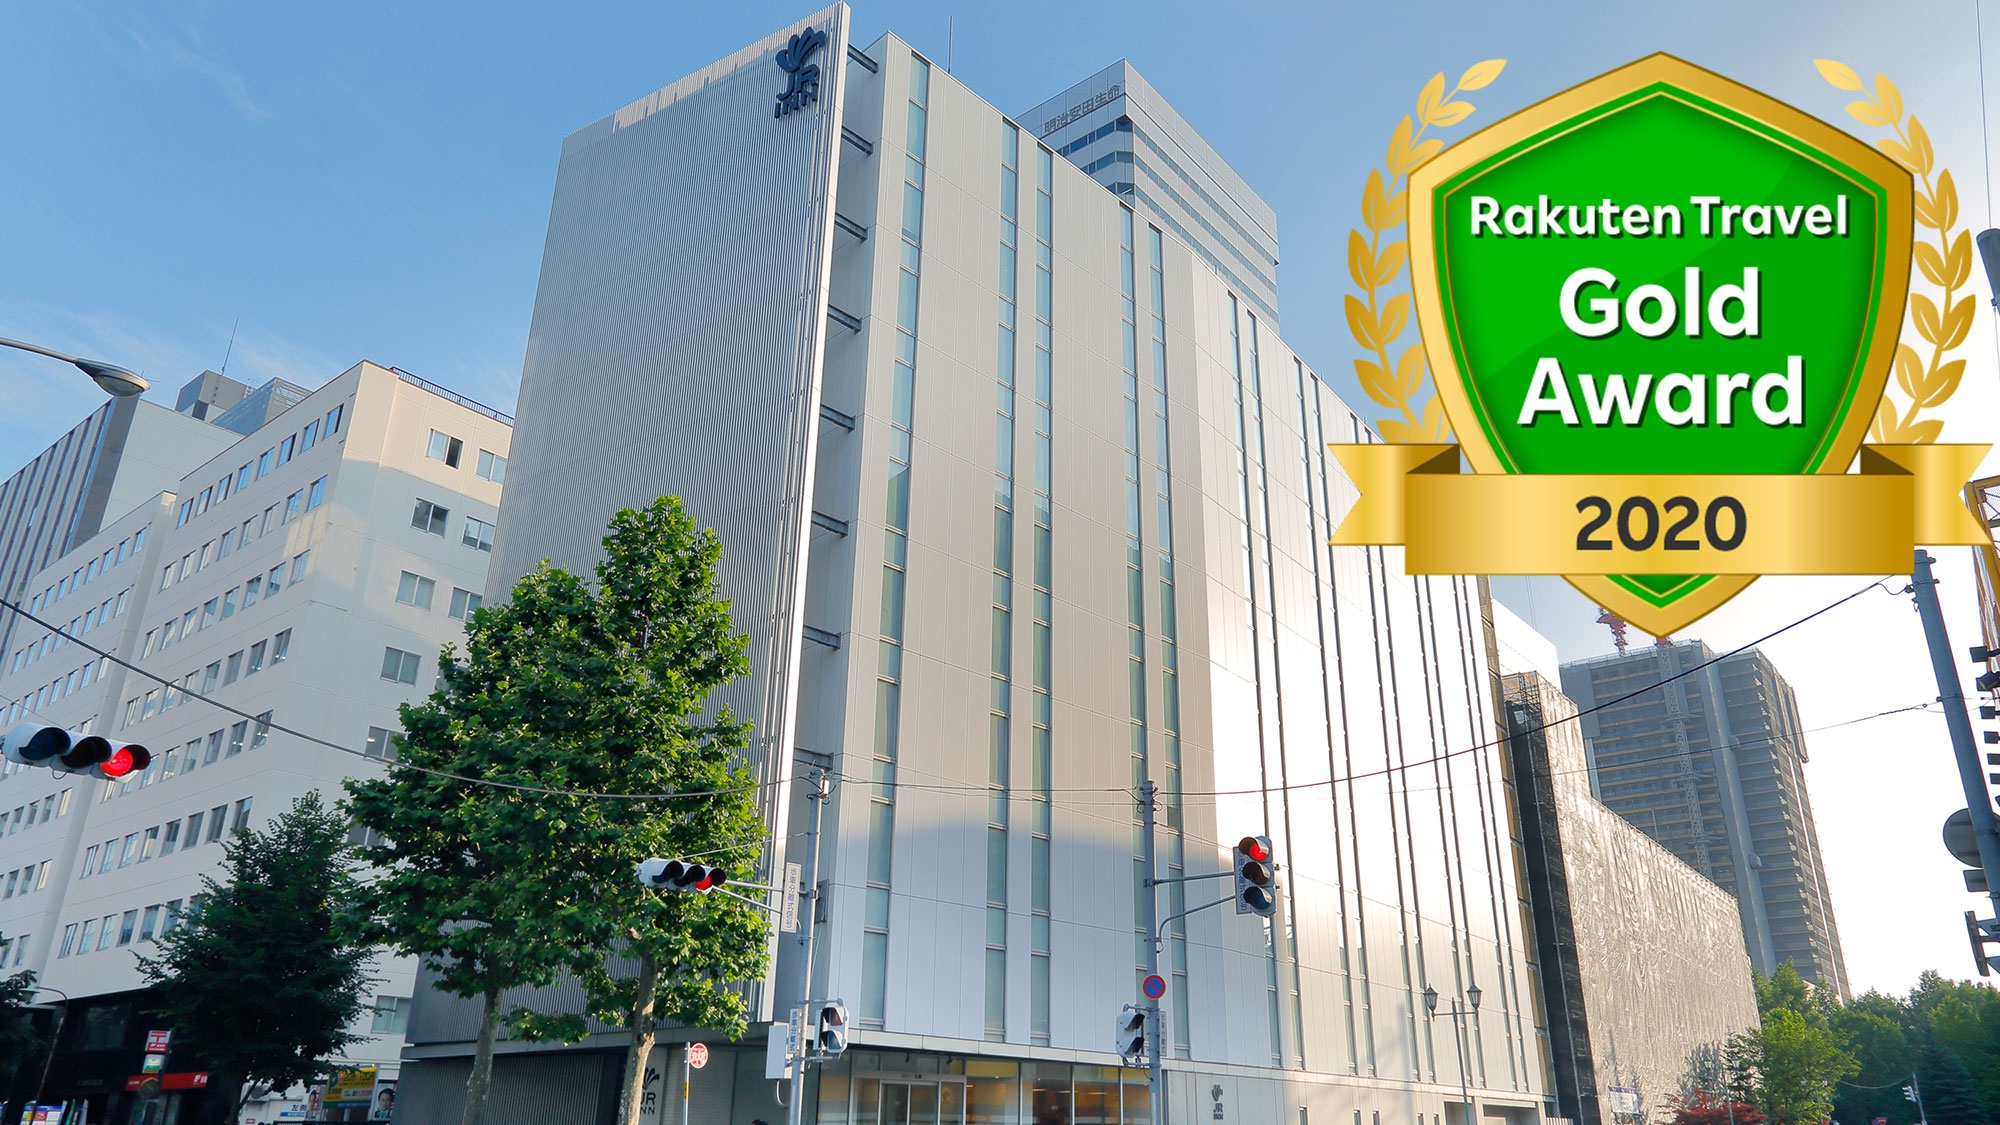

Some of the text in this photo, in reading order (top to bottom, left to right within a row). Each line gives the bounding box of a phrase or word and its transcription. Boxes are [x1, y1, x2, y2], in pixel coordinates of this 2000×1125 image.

[776, 64, 820, 101] JR
[774, 85, 818, 119] INN
[1044, 84, 1121, 133] 明治安田生命
